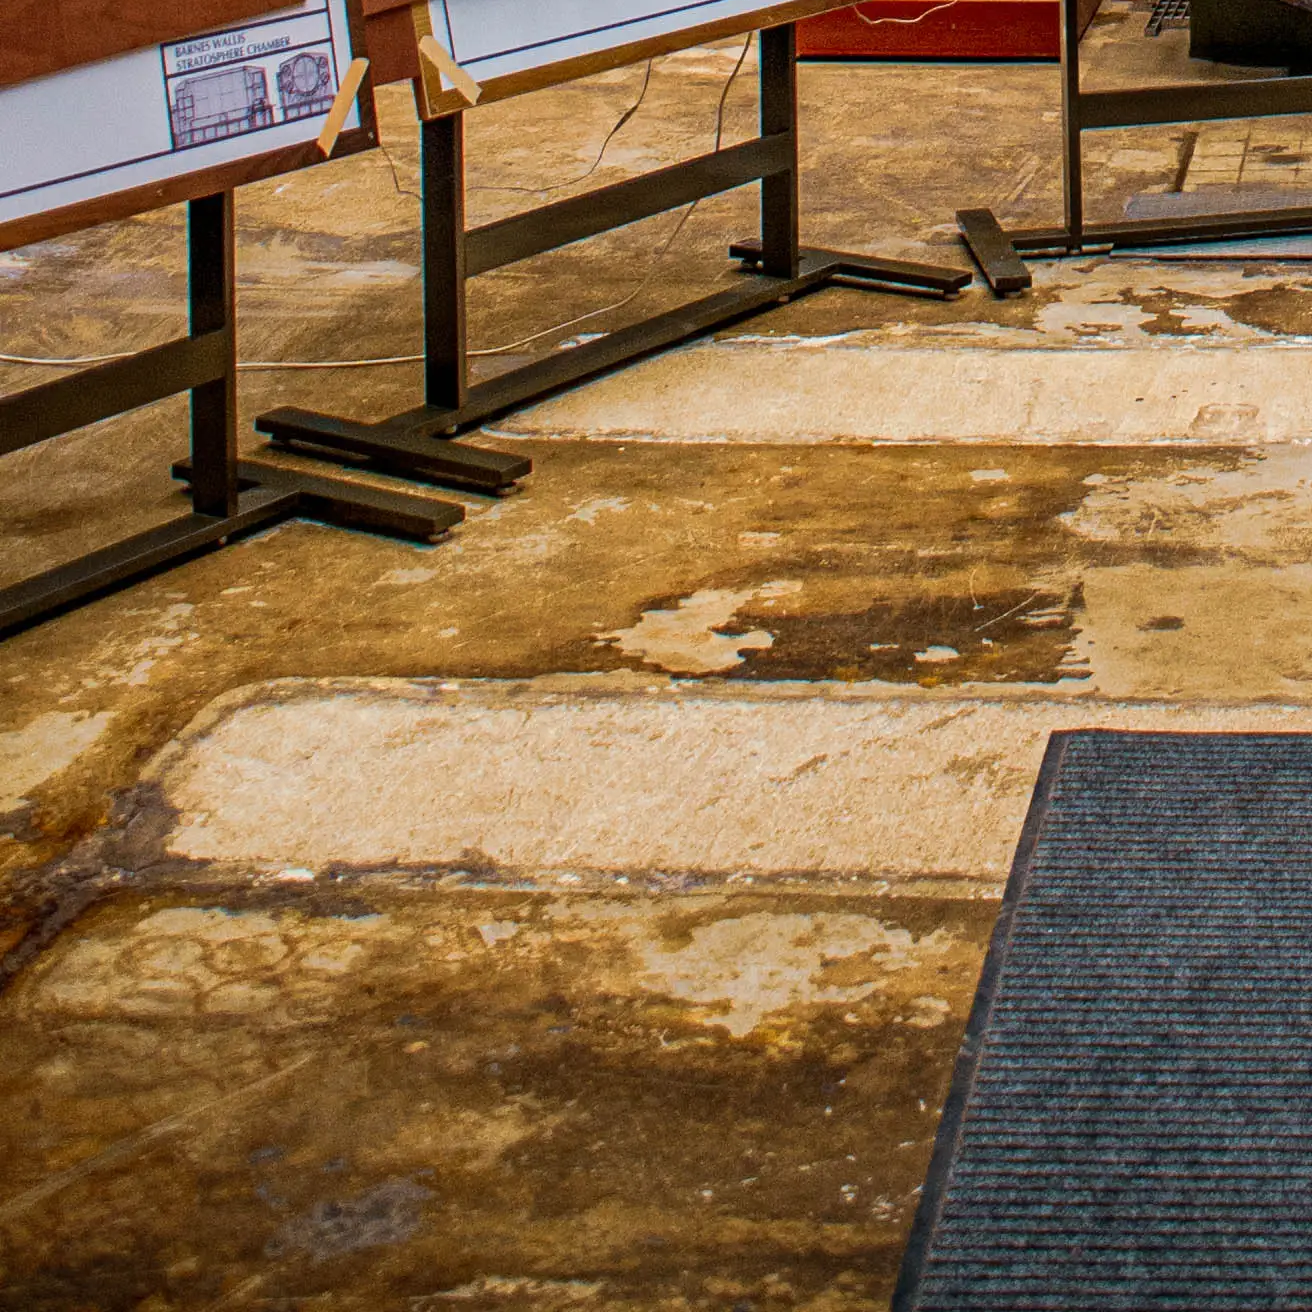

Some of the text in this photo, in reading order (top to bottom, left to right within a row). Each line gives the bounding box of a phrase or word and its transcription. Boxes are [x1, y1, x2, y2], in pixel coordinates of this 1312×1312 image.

[175, 33, 246, 57] BARNES WALLIS
[176, 37, 290, 69] STRATOSPHERE CHAMBER
